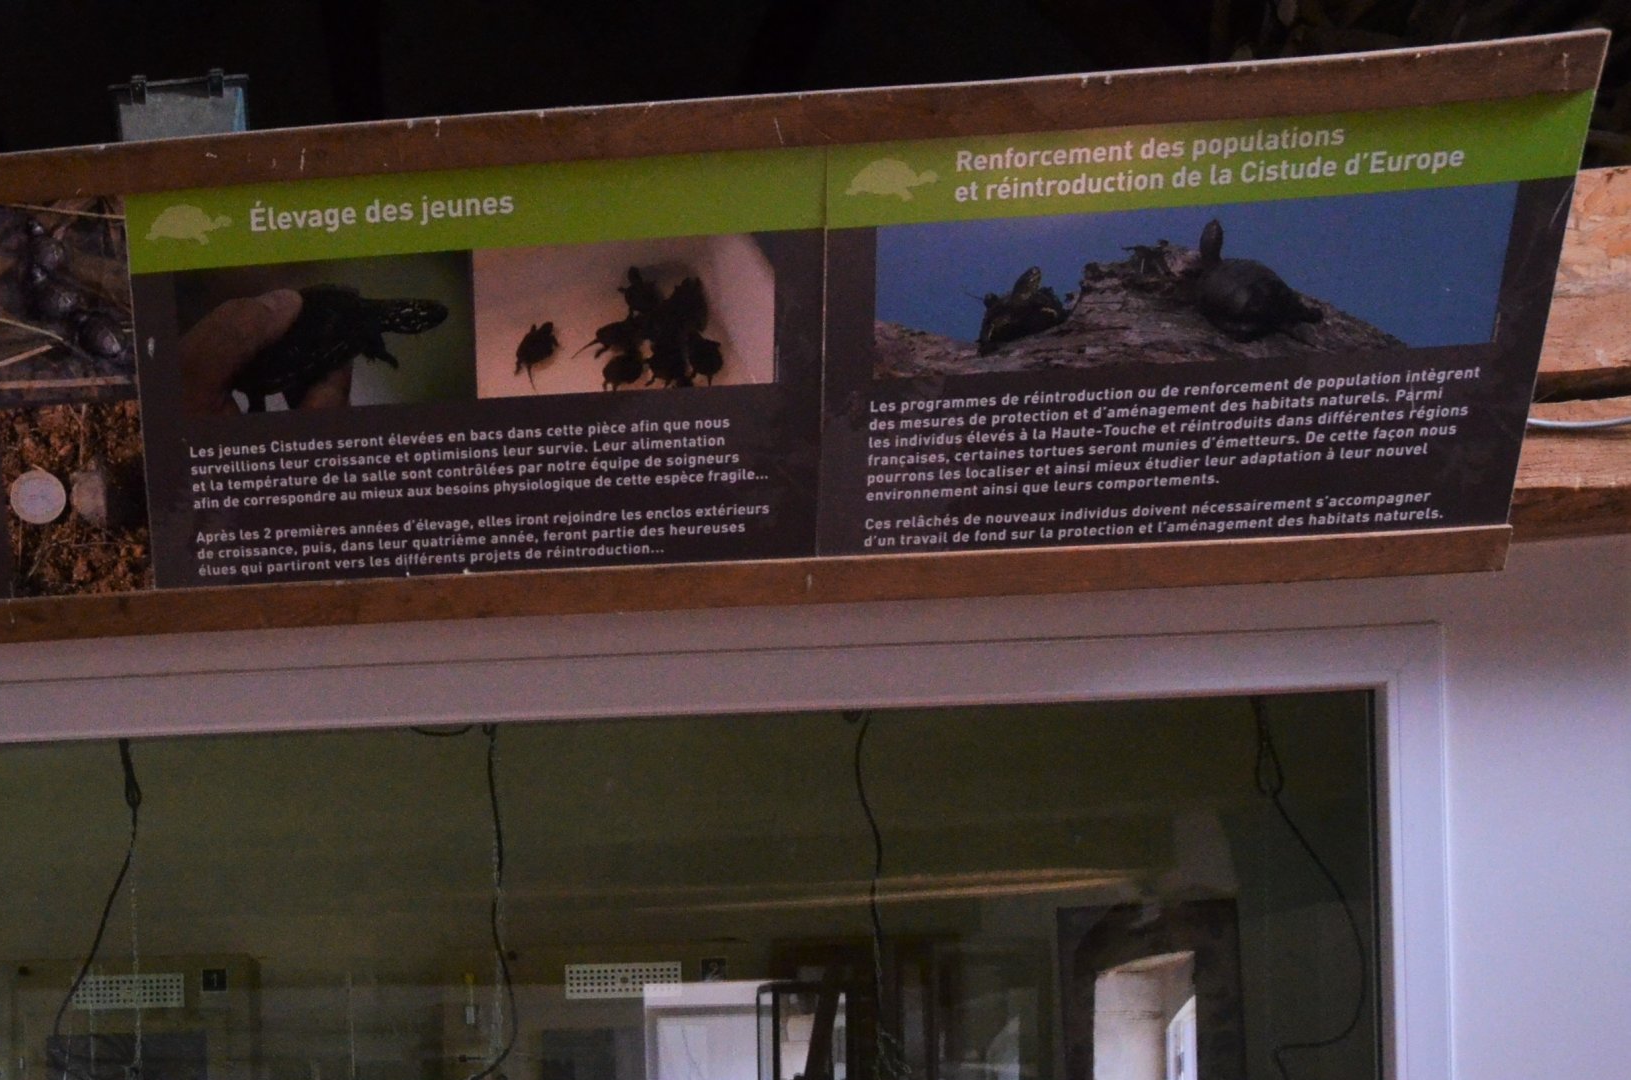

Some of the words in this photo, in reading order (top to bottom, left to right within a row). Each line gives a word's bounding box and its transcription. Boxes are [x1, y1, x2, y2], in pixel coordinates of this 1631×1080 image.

[955, 140, 1134, 172] Renforcement
[1140, 138, 1185, 160] des
[1191, 127, 1346, 161] populations
[954, 181, 979, 203] et
[986, 169, 1164, 200] réintroduction
[1171, 165, 1202, 189] de
[1209, 163, 1233, 185] la
[1240, 156, 1338, 183] Cistude
[1344, 149, 1466, 176] d'Europe
[249, 201, 357, 233] Élevage
[365, 199, 415, 224] des
[420, 196, 515, 226] jeunes
[870, 400, 895, 412] Les
[900, 397, 996, 413] programmes
[1001, 393, 1019, 405] de
[1024, 387, 1133, 403] réintroduction
[1137, 388, 1156, 397] ou
[1160, 384, 1179, 396] de
[1183, 378, 1289, 394] renforcement
[1293, 376, 1312, 388] de
[1316, 372, 1401, 390] population
[1405, 367, 1480, 383] intègrent
[189, 445, 214, 456] Les
[218, 443, 266, 457] jeunes
[270, 438, 332, 451] Cistudes
[337, 435, 383, 448] seront
[387, 432, 443, 445] élevées
[448, 433, 465, 442] en
[470, 429, 502, 440] bacs
[507, 427, 542, 438] dans
[546, 424, 583, 436] cette
[587, 422, 626, 437] pièce
[630, 419, 658, 431] afin
[663, 420, 690, 432] que
[695, 418, 730, 428] nous
[868, 437, 890, 448] les
[895, 433, 962, 447] individus
[966, 429, 1014, 443] élevés
[1019, 428, 1028, 440] à
[1032, 427, 1046, 439] la
[1051, 421, 1156, 438] Haute-Touche
[1160, 421, 1175, 432] et
[1180, 415, 1272, 431] réintroduits
[1276, 414, 1313, 426] dans
[1317, 409, 1404, 424] différentes
[1408, 405, 1468, 421] régions
[190, 459, 275, 473] surveillions
[279, 457, 309, 468] leur
[314, 454, 390, 467] croissance
[395, 452, 409, 462] et
[414, 447, 498, 463] optimisions
[503, 445, 532, 456] leur
[537, 441, 587, 454] survie.
[593, 440, 626, 451] Leur
[631, 434, 725, 449] alimentation
[864, 535, 895, 546] d'un
[900, 531, 947, 544] travail
[952, 531, 969, 542] de
[974, 528, 1006, 541] fond
[1011, 530, 1034, 539] sur
[1039, 527, 1053, 537] la
[1057, 523, 1133, 539] protection
[1138, 522, 1153, 533] et
[1277, 515, 1304, 526] des
[1308, 512, 1370, 524] habitats
[1374, 507, 1442, 521] naturels.
[198, 564, 236, 575] élues
[241, 561, 262, 575] qui
[266, 559, 330, 574] partiront
[334, 559, 365, 568] vers
[369, 555, 390, 566] les
[394, 552, 465, 565] différents
[470, 549, 520, 564] projets
[524, 547, 541, 558] de
